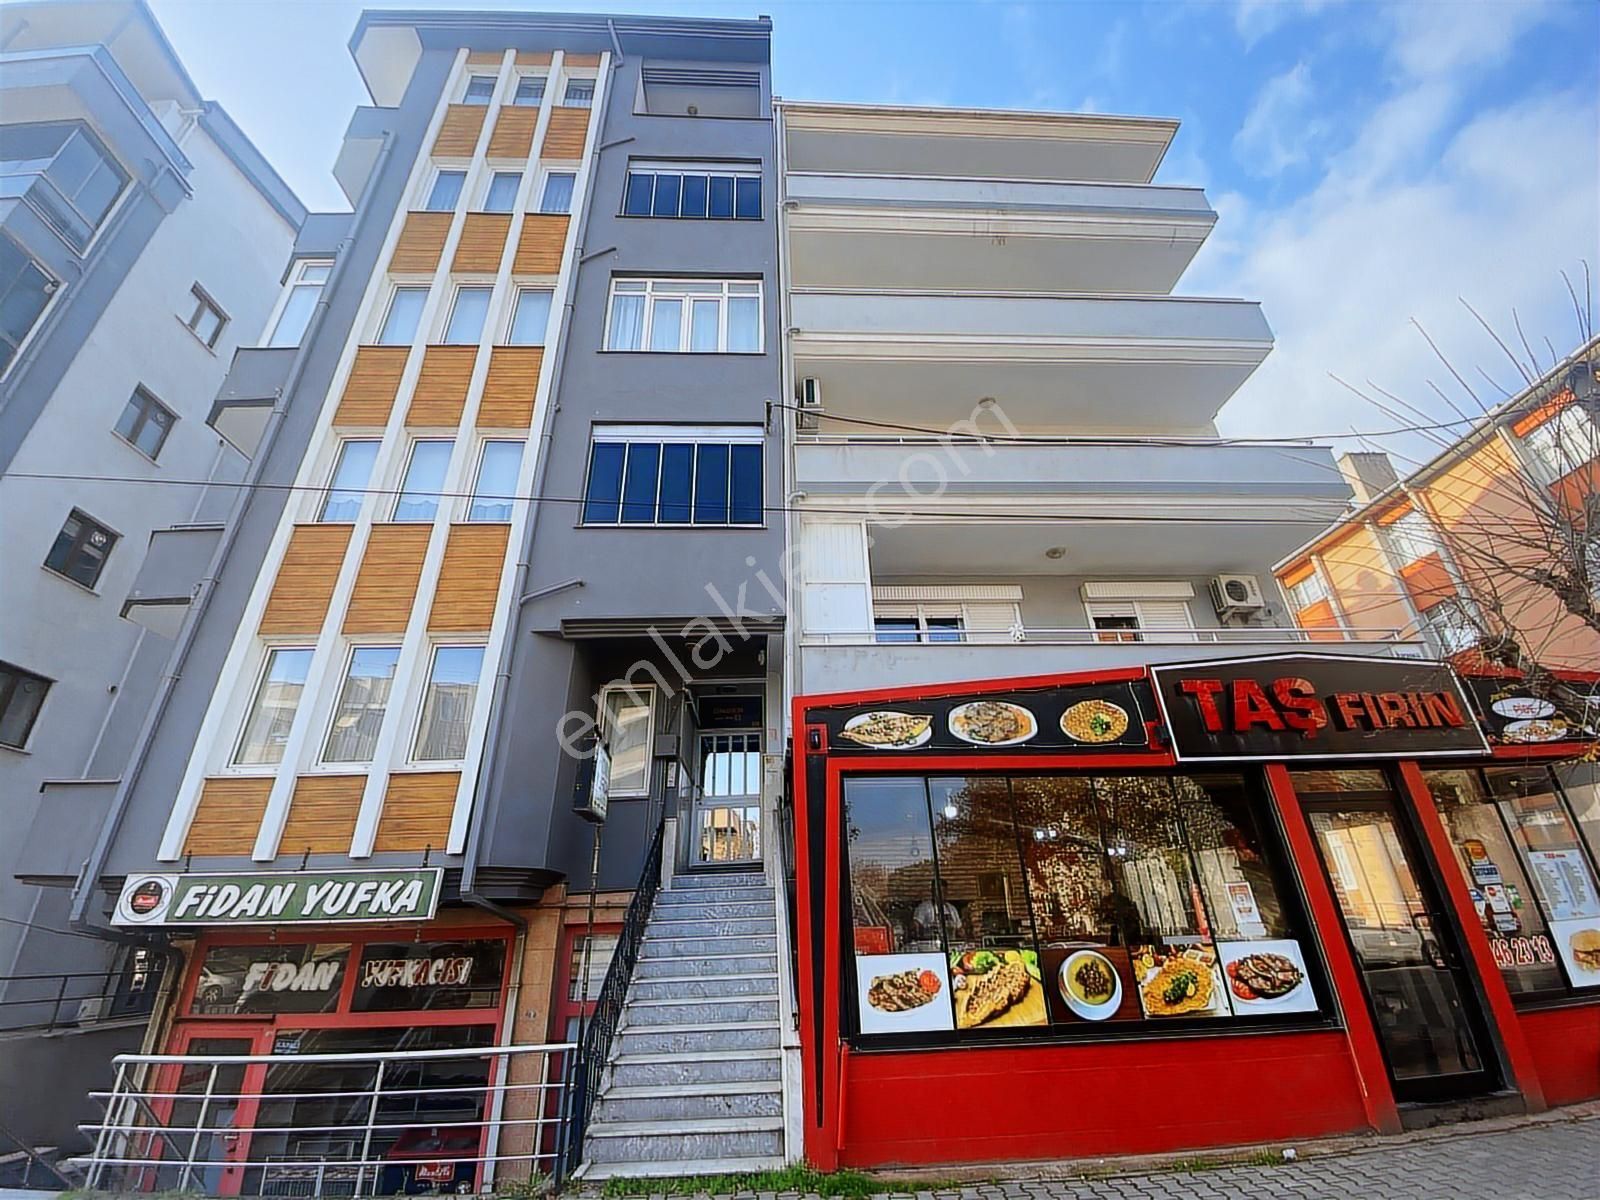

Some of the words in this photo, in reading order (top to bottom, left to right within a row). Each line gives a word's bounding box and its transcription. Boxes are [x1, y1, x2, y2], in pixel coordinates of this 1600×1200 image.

[1178, 678, 1328, 739] TAŞ
[1332, 690, 1466, 729] FIRIN
[300, 879, 424, 916] YUFKA
